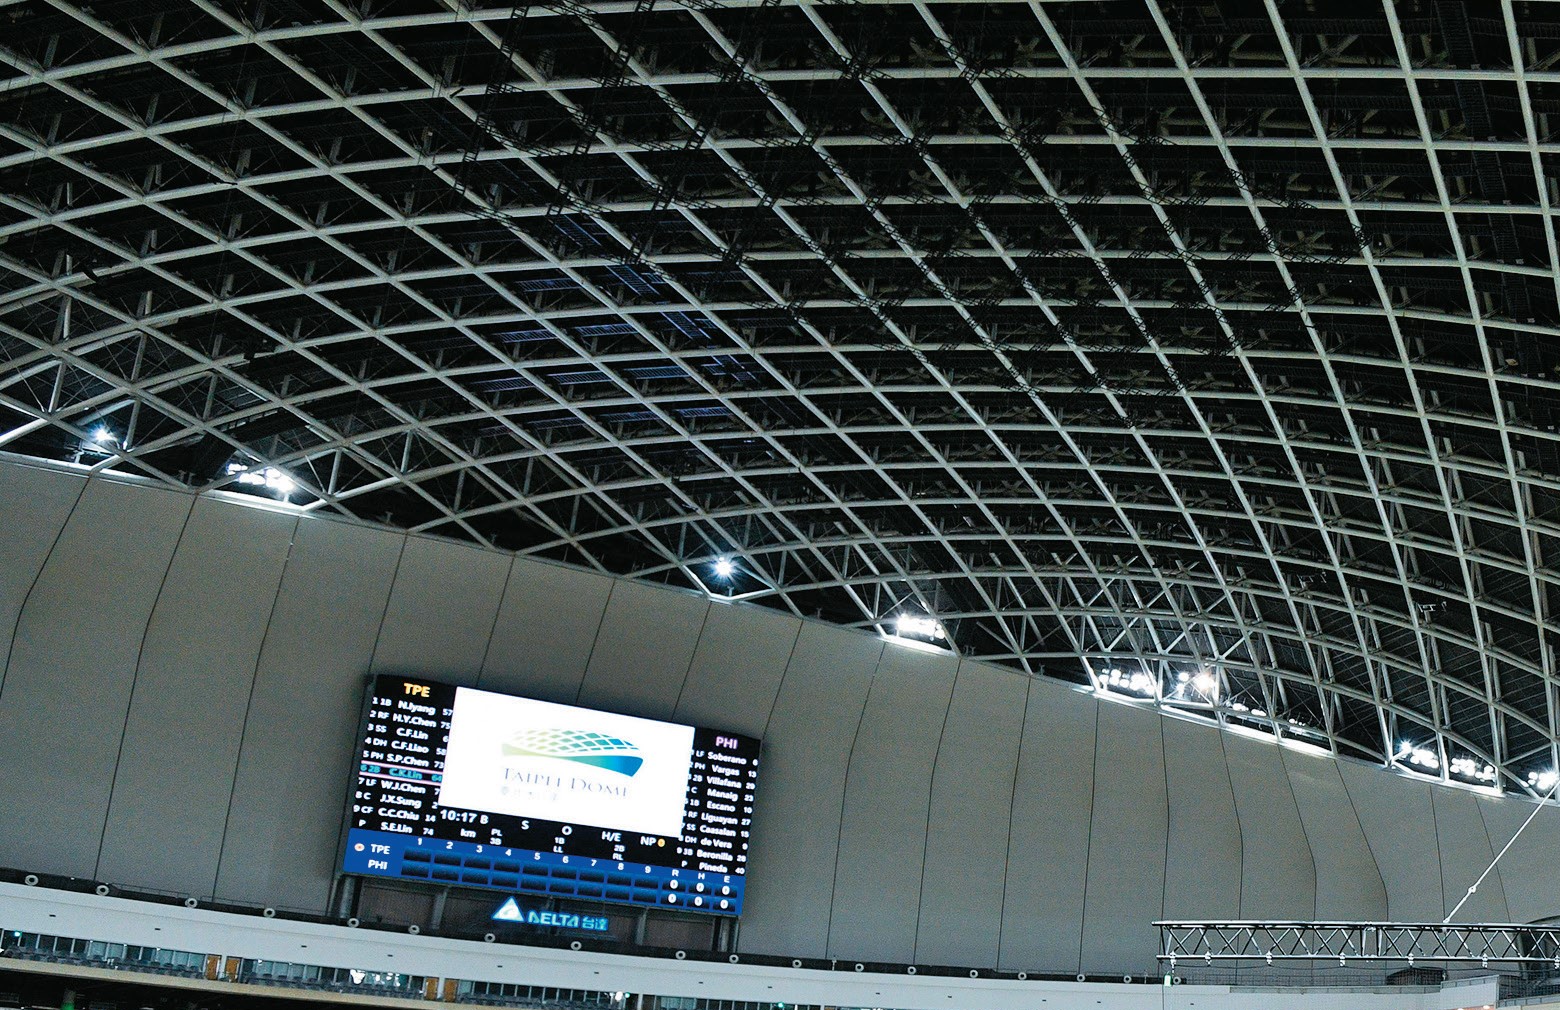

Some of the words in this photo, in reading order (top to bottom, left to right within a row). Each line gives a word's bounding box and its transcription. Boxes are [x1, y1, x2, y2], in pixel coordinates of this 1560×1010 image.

[404, 683, 430, 698] TPE
[380, 698, 392, 706] 1B
[442, 708, 453, 716] 57
[370, 710, 376, 718] 2
[378, 711, 389, 719] RF
[392, 713, 436, 727] H.Y.Chen
[440, 721, 451, 729] 75
[376, 724, 387, 733] SS
[396, 728, 428, 740] C.F.Lin
[373, 738, 387, 746] DH
[716, 736, 738, 749] PHI
[363, 750, 369, 758] 5
[371, 751, 384, 760] PH
[387, 753, 429, 767] S.P.Chen
[434, 761, 444, 769] 73
[708, 751, 747, 765] Soberano
[361, 764, 367, 772] 6
[368, 765, 381, 773] 2B
[389, 768, 422, 780] C.K.Lin
[432, 774, 442, 782] 64
[712, 764, 740, 776] Vargas
[748, 770, 757, 778] 13
[366, 778, 377, 786] LF
[381, 780, 426, 794] W.J.Chen
[693, 774, 703, 782] 2B
[706, 776, 742, 789] Villafana
[380, 794, 422, 809] J.X.Sung
[691, 786, 698, 794] C
[707, 788, 738, 802] Manaig
[361, 806, 374, 814] CF
[378, 808, 420, 820] C.C.Chiu
[425, 814, 436, 822] 14
[701, 812, 738, 825] Liguayan
[741, 818, 751, 826] 27
[359, 819, 366, 827] P
[381, 822, 413, 834] S.E.Lin
[423, 828, 434, 836] 74
[440, 809, 477, 823] 10:17
[480, 815, 488, 824] B
[522, 820, 530, 830] S
[562, 825, 572, 835] O
[601, 831, 622, 842] H/E
[640, 836, 656, 846] NP
[658, 838, 665, 847] 0
[686, 823, 696, 831] SS
[460, 828, 476, 838] km
[491, 828, 502, 836] PL
[555, 837, 565, 845] 1B
[614, 845, 625, 853] 2B
[700, 838, 712, 846] de
[713, 839, 732, 849] Vera
[446, 841, 454, 849] 2
[476, 845, 483, 853] 3
[534, 852, 540, 860] 5
[563, 856, 569, 864] 6
[618, 863, 624, 871] 8
[672, 869, 679, 877] R
[724, 875, 730, 883] E
[696, 849, 733, 862] Beronilla
[371, 844, 390, 854] TPE
[670, 880, 678, 889] 0
[696, 882, 704, 892] 0
[722, 886, 730, 895] 0
[699, 862, 728, 873] Pineda
[368, 859, 388, 870] PHI
[668, 894, 676, 903] 0
[694, 896, 703, 906] 0
[720, 899, 728, 909] 0
[528, 910, 580, 928] DELTA
